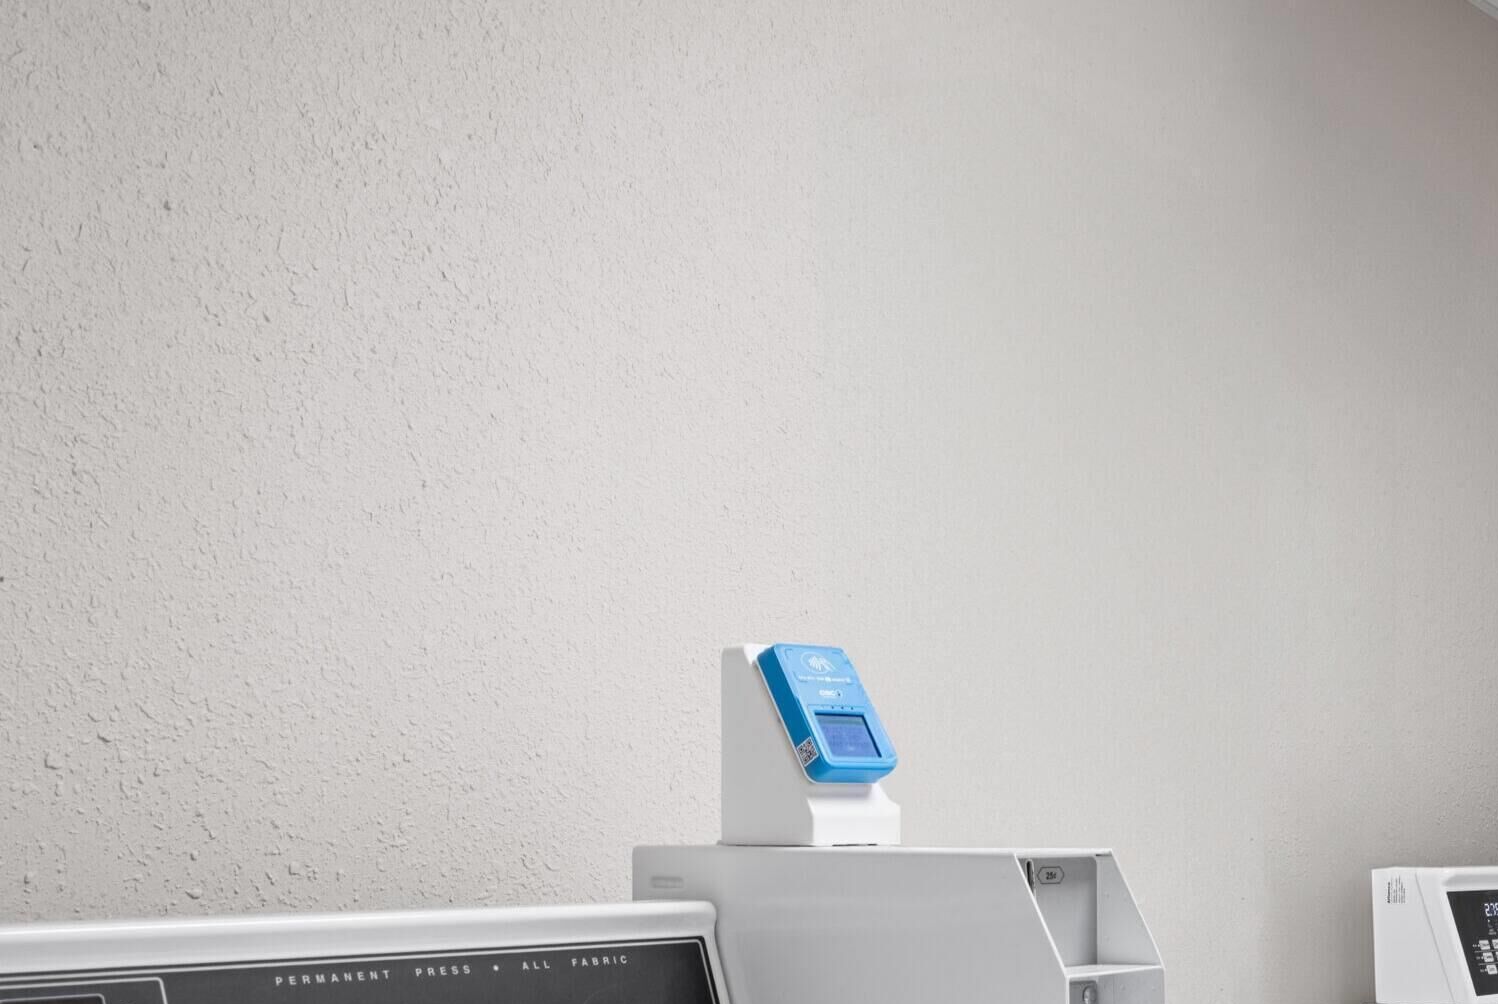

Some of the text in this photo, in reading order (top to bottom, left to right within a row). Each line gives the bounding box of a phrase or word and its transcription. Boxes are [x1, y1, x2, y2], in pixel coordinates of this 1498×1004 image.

[275, 954, 629, 986] PERMANENT PRESS ALL FABRIC
